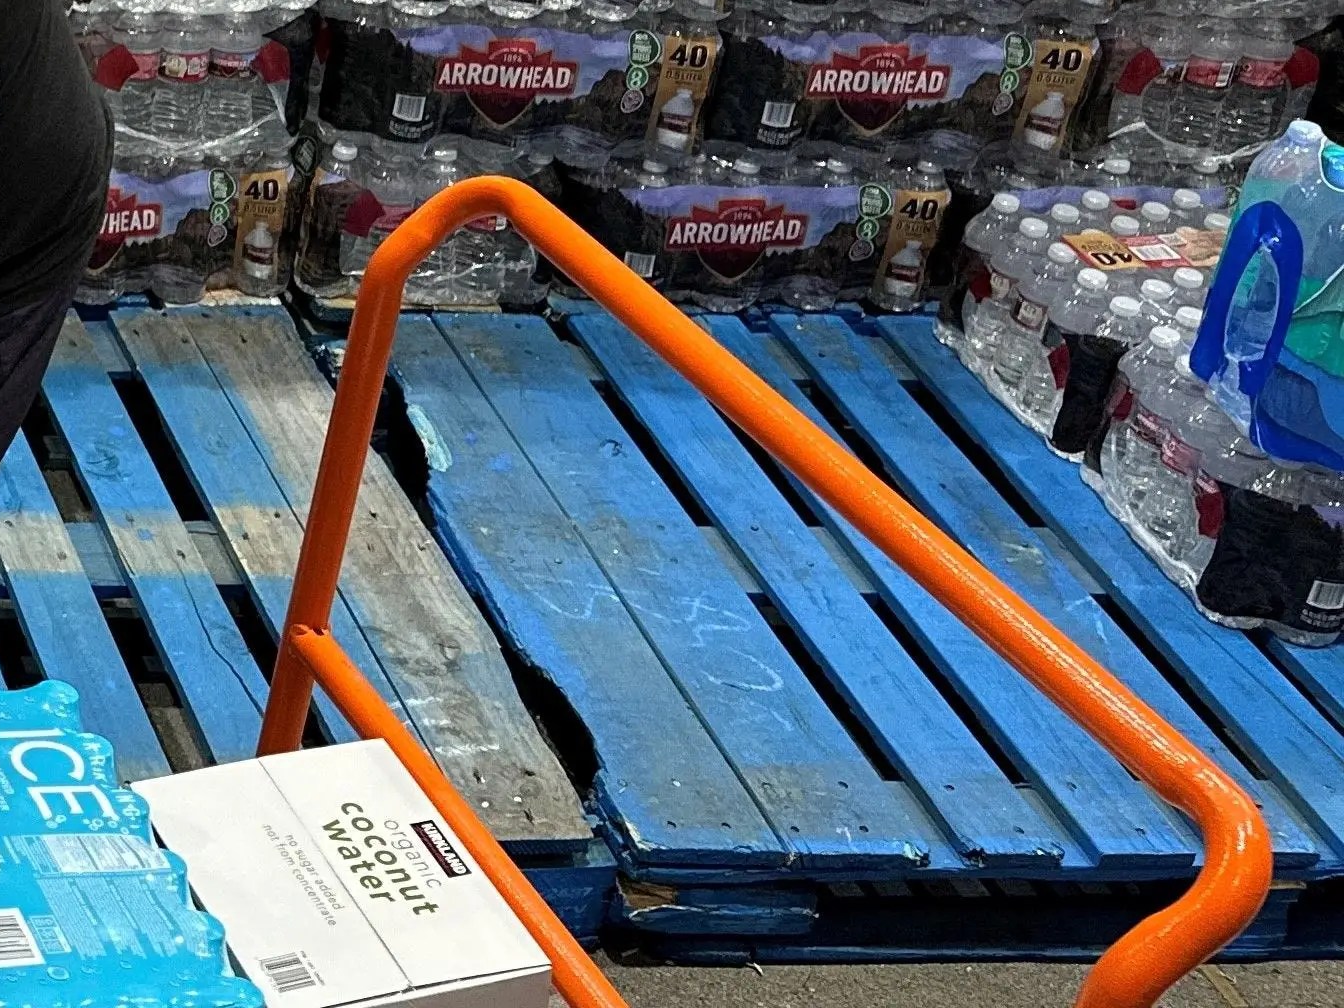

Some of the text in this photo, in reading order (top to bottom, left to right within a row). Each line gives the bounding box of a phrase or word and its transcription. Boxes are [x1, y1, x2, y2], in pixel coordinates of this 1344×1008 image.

[668, 44, 708, 69] 40
[1040, 48, 1083, 72] 40
[438, 63, 572, 91] ARROWHEAD
[809, 69, 945, 95] ARROWHEAD
[245, 178, 280, 202] 40
[900, 198, 939, 222] 40
[668, 218, 801, 246] ARROWHEAD
[322, 818, 396, 904] water
[340, 801, 439, 917] coconut
[384, 818, 443, 890] organic
[422, 821, 467, 874] KIRKLAND
[263, 824, 336, 926] not from concentrate
[285, 834, 345, 910] no sugar added
